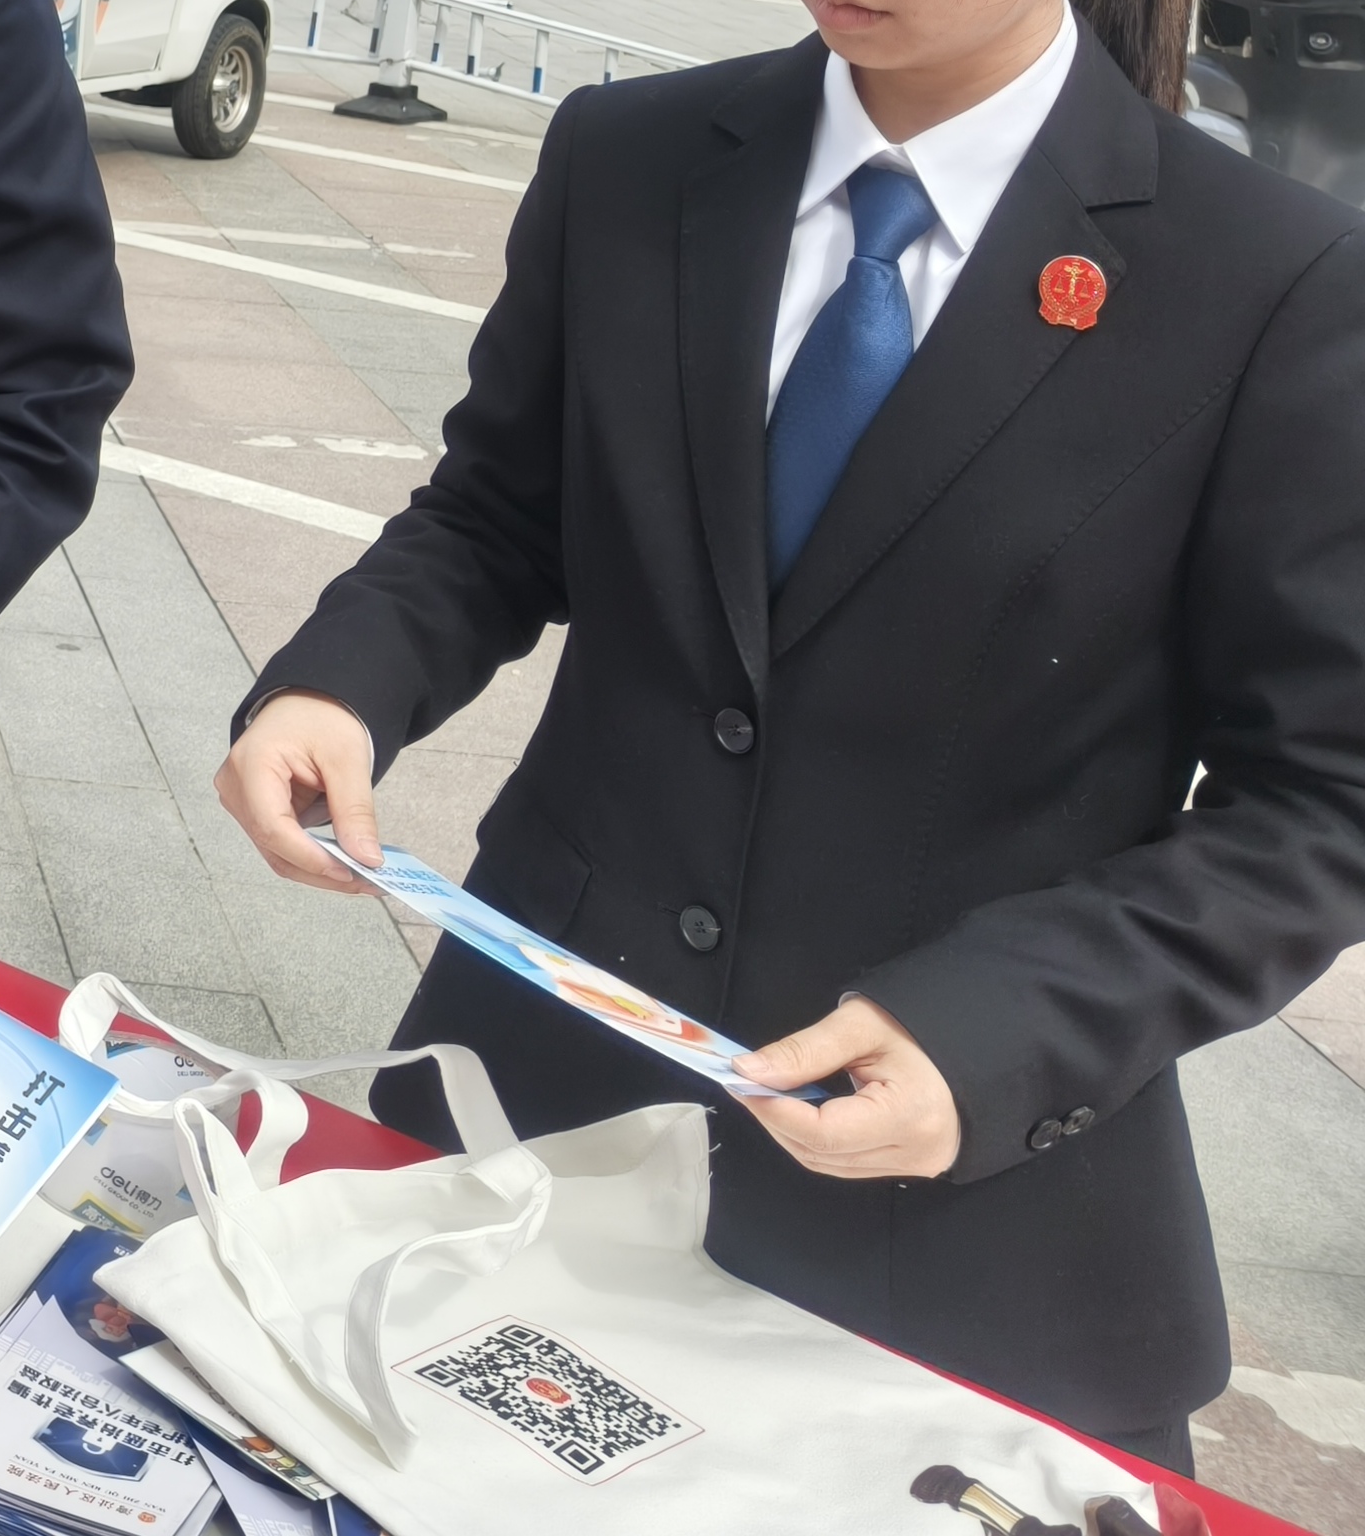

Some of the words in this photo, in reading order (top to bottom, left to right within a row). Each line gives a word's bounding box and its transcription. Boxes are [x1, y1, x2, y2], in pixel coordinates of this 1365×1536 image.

[6, 1378, 196, 1466] 打击惩治养老诈骗
